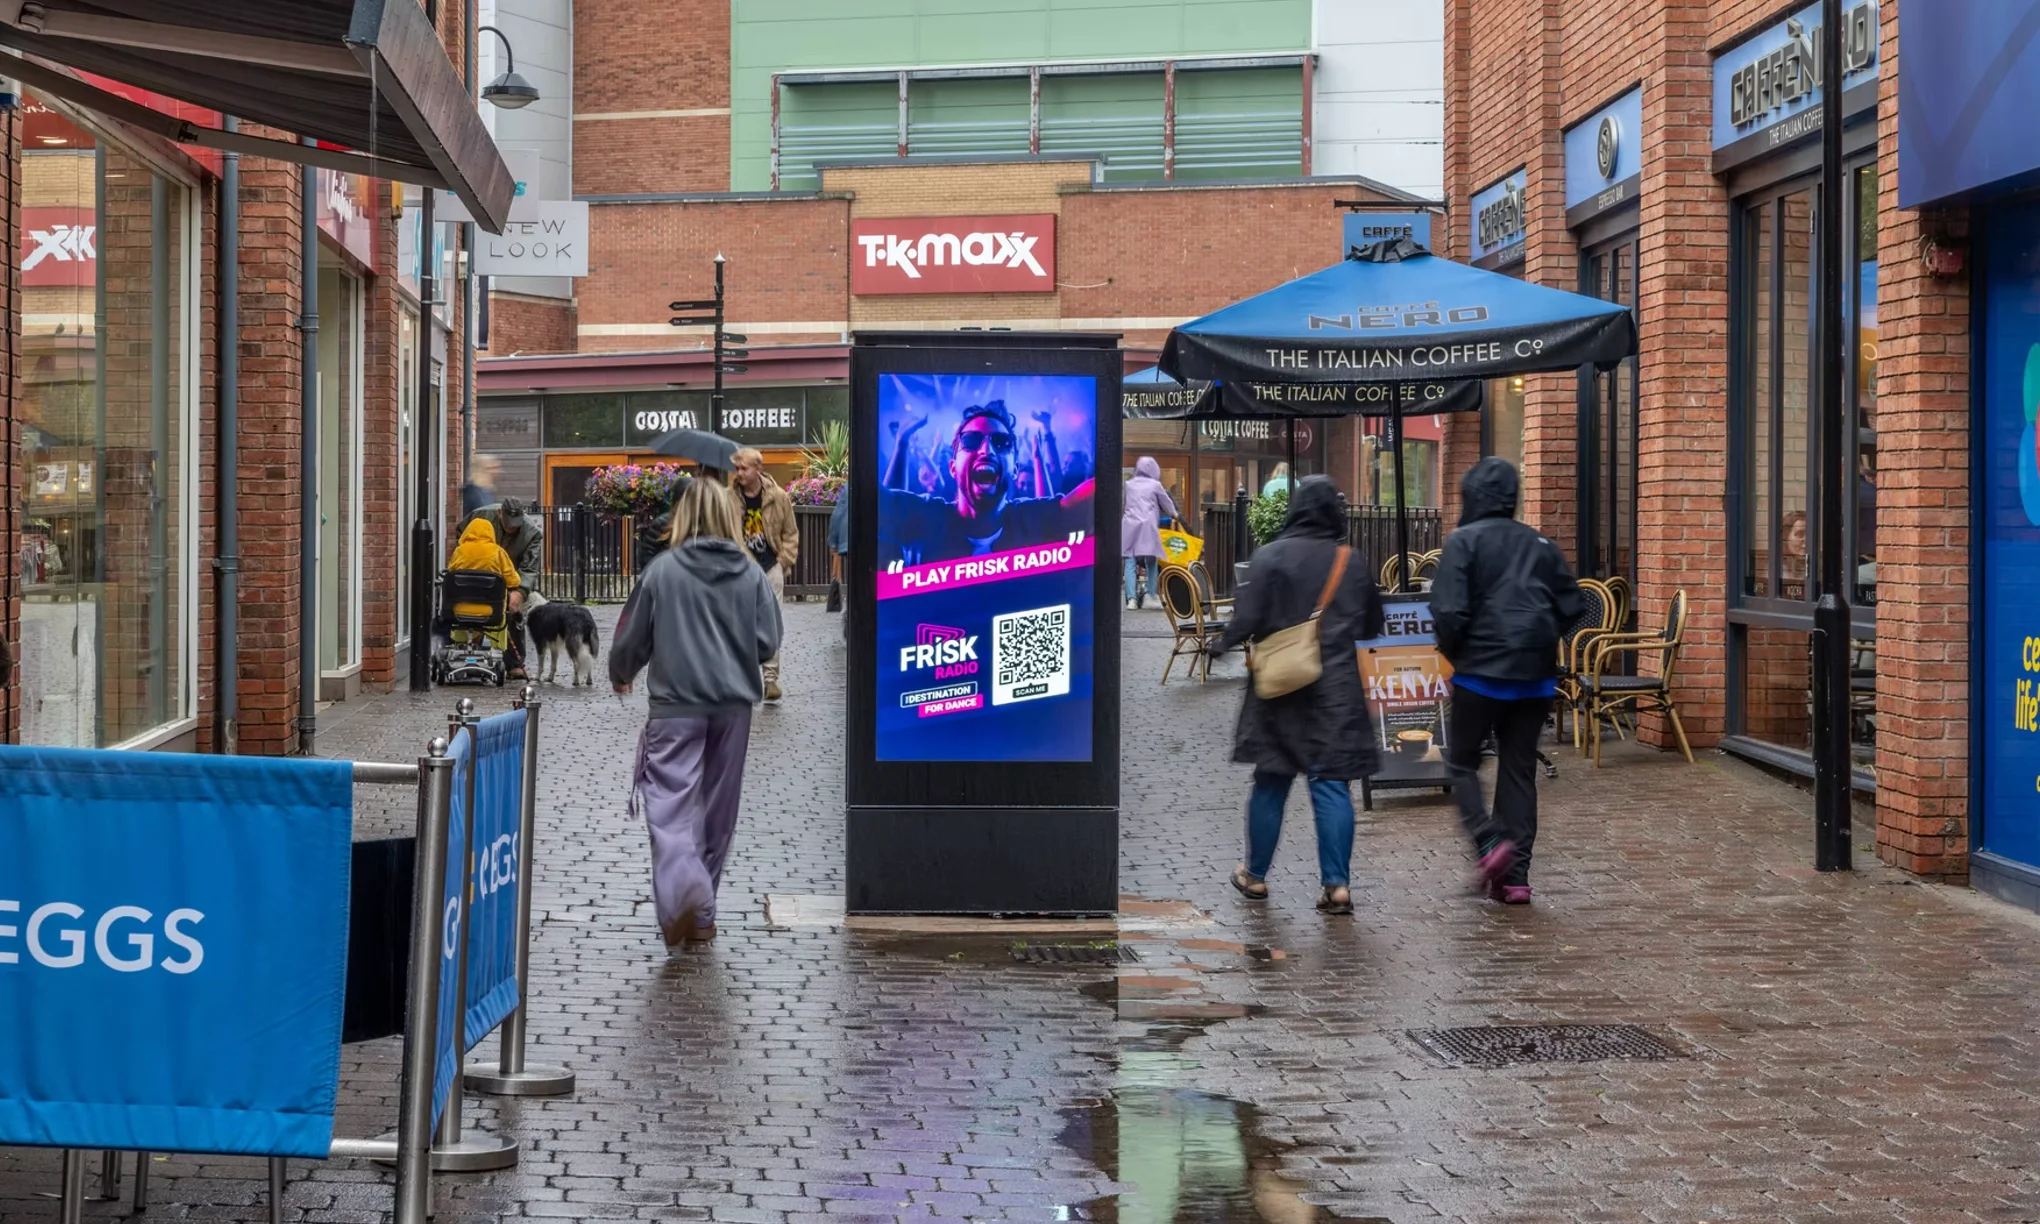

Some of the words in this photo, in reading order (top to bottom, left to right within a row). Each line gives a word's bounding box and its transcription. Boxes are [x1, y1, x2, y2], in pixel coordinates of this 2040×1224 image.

[1800, 0, 1877, 95] NRO
[1769, 126, 1780, 146] THE
[1780, 115, 1802, 142] ITALIAN
[490, 241, 572, 258] LOOK
[1309, 305, 1490, 330] NERO
[1266, 349, 1309, 369] THE
[1318, 348, 1403, 369] ITALIAN
[1411, 342, 1501, 366] COFFEE
[1122, 393, 1138, 407] THE
[1139, 392, 1166, 407] ITALIAN
[1253, 385, 1282, 401] THE
[1287, 386, 1346, 401] ITALIAN
[1355, 385, 1416, 402] COFEE
[635, 410, 698, 433] COSTA
[1240, 420, 1269, 439] COFFEE
[955, 556, 1009, 581] FRISK
[1386, 610, 1418, 620] CAFFÈ
[1386, 620, 1436, 636] ERO
[1015, 687, 1035, 697] SCAN
[1035, 684, 1046, 693] ME
[1368, 671, 1450, 701] KENYA
[924, 704, 944, 714] FOR
[945, 697, 977, 711] DANCE
